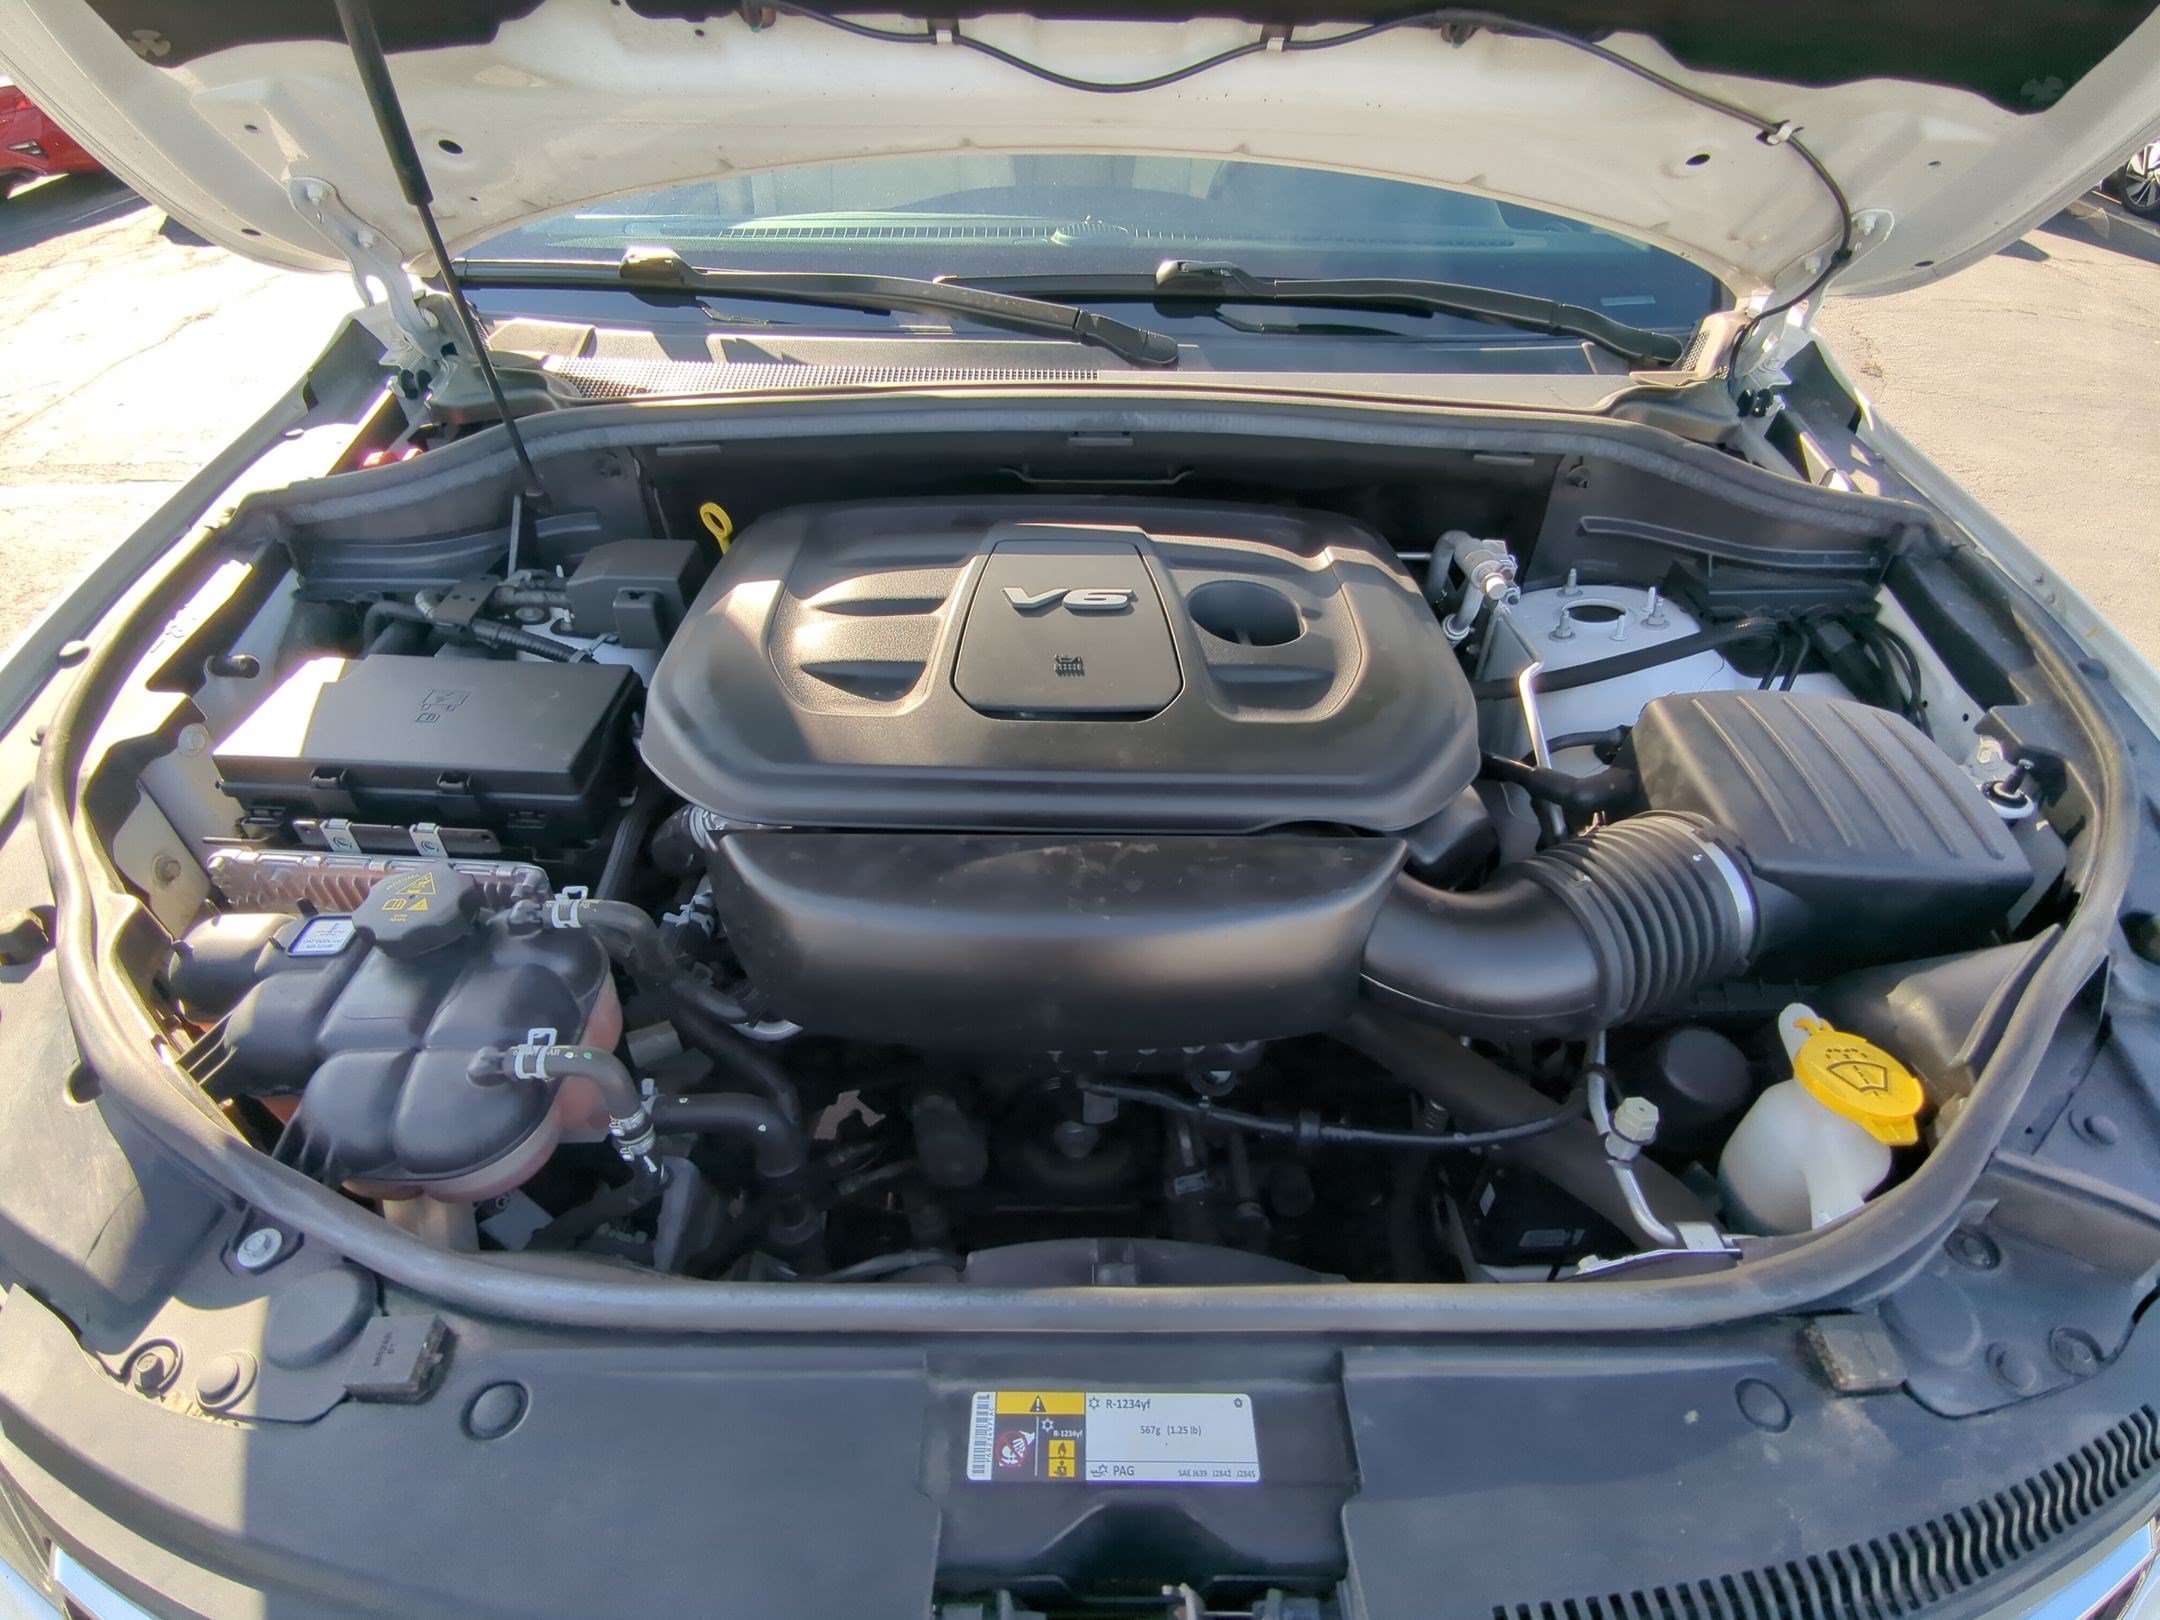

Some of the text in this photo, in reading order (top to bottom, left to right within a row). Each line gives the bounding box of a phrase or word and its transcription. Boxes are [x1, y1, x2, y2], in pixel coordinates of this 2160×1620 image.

[1001, 586, 1136, 609] V6
[1106, 1398, 1151, 1411] R-1234yf
[1053, 1430, 1083, 1440] R-1234yf
[1140, 1424, 1202, 1436] 567g (1.25 lb)
[1113, 1465, 1135, 1476] PAG
[1178, 1469, 1191, 1477] SAE
